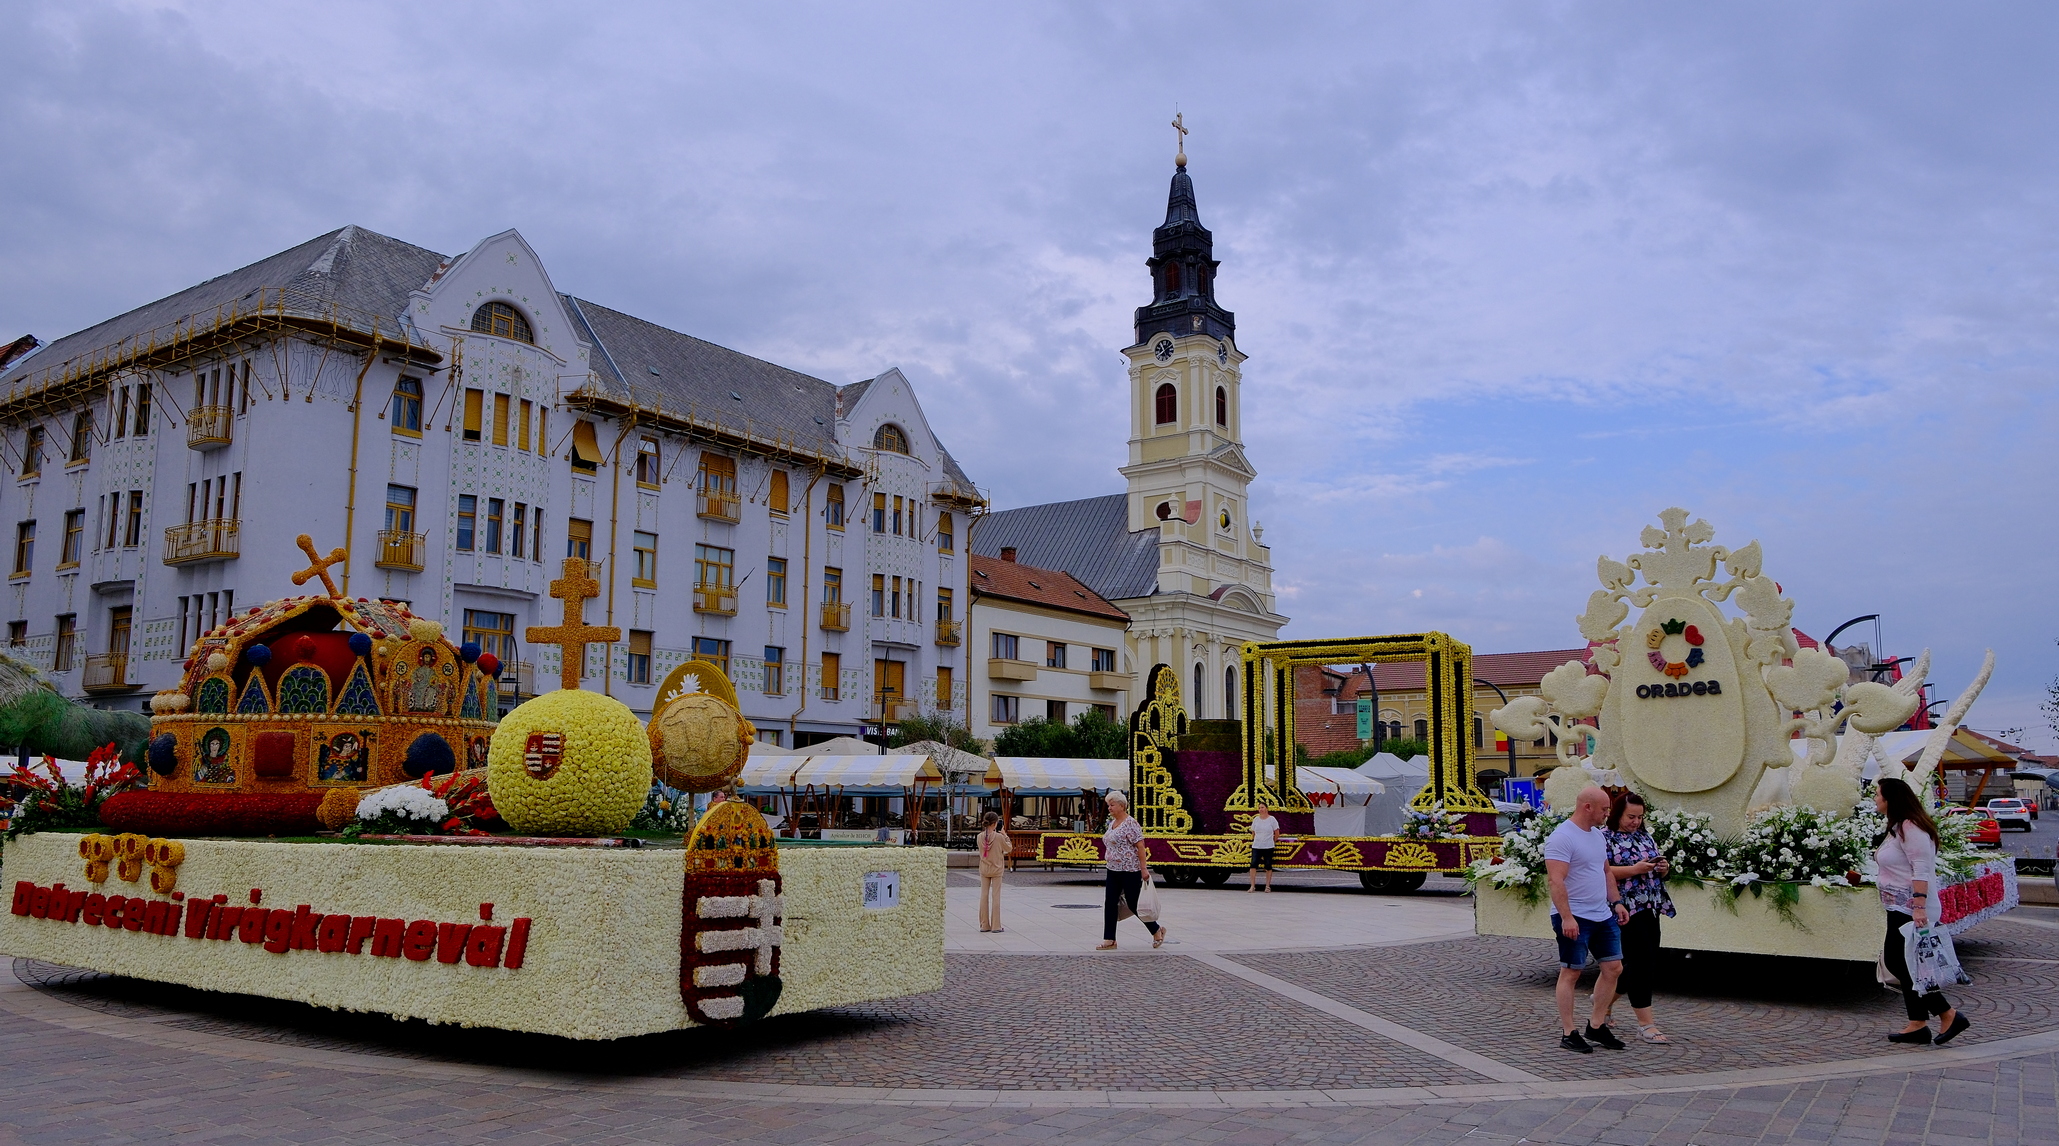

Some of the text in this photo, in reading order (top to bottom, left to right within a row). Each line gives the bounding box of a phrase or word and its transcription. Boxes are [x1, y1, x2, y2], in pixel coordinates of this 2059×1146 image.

[887, 883, 893, 898] 1
[11, 880, 532, 969] Debreceni Virágkarnevál
